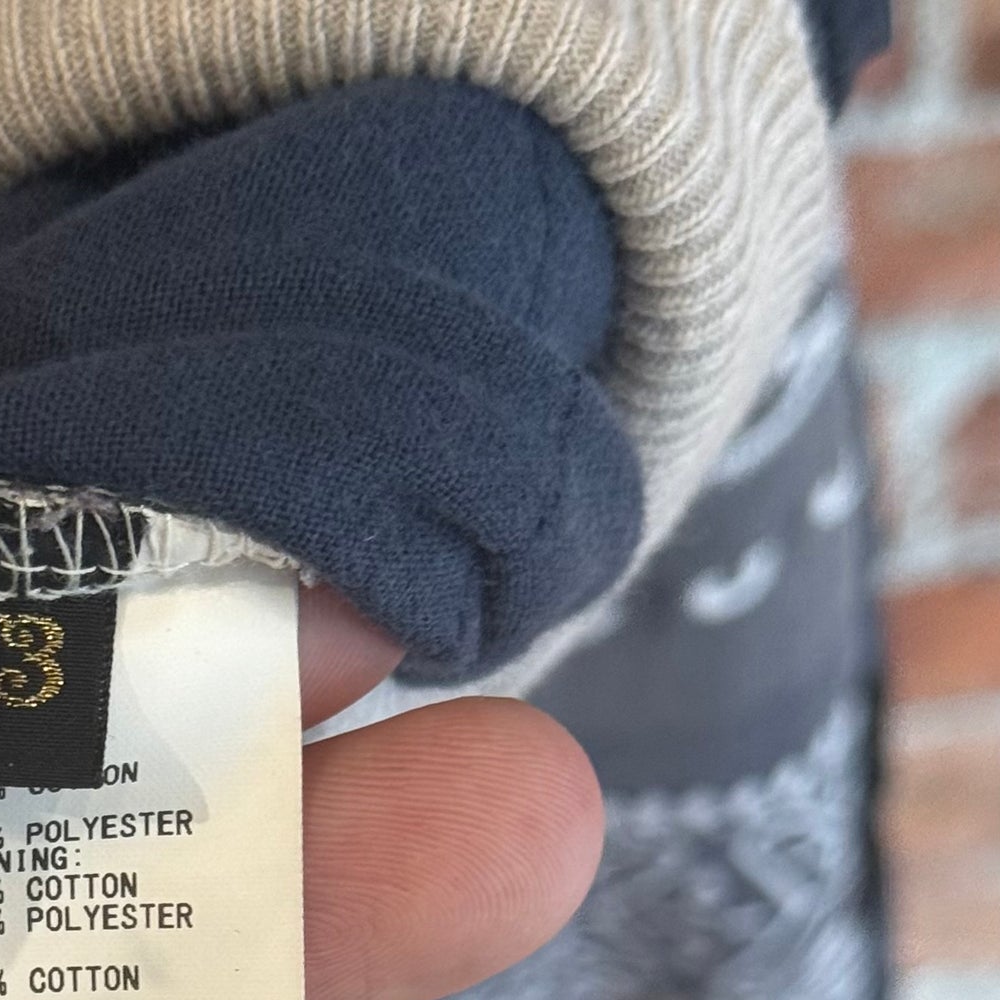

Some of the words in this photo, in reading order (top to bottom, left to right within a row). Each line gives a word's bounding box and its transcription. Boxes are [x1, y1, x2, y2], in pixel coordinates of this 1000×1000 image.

[25, 810, 194, 846] POLYESTER
[25, 873, 139, 900] COTTON
[26, 904, 195, 932] POLYESTER
[28, 966, 141, 993] COTTON
